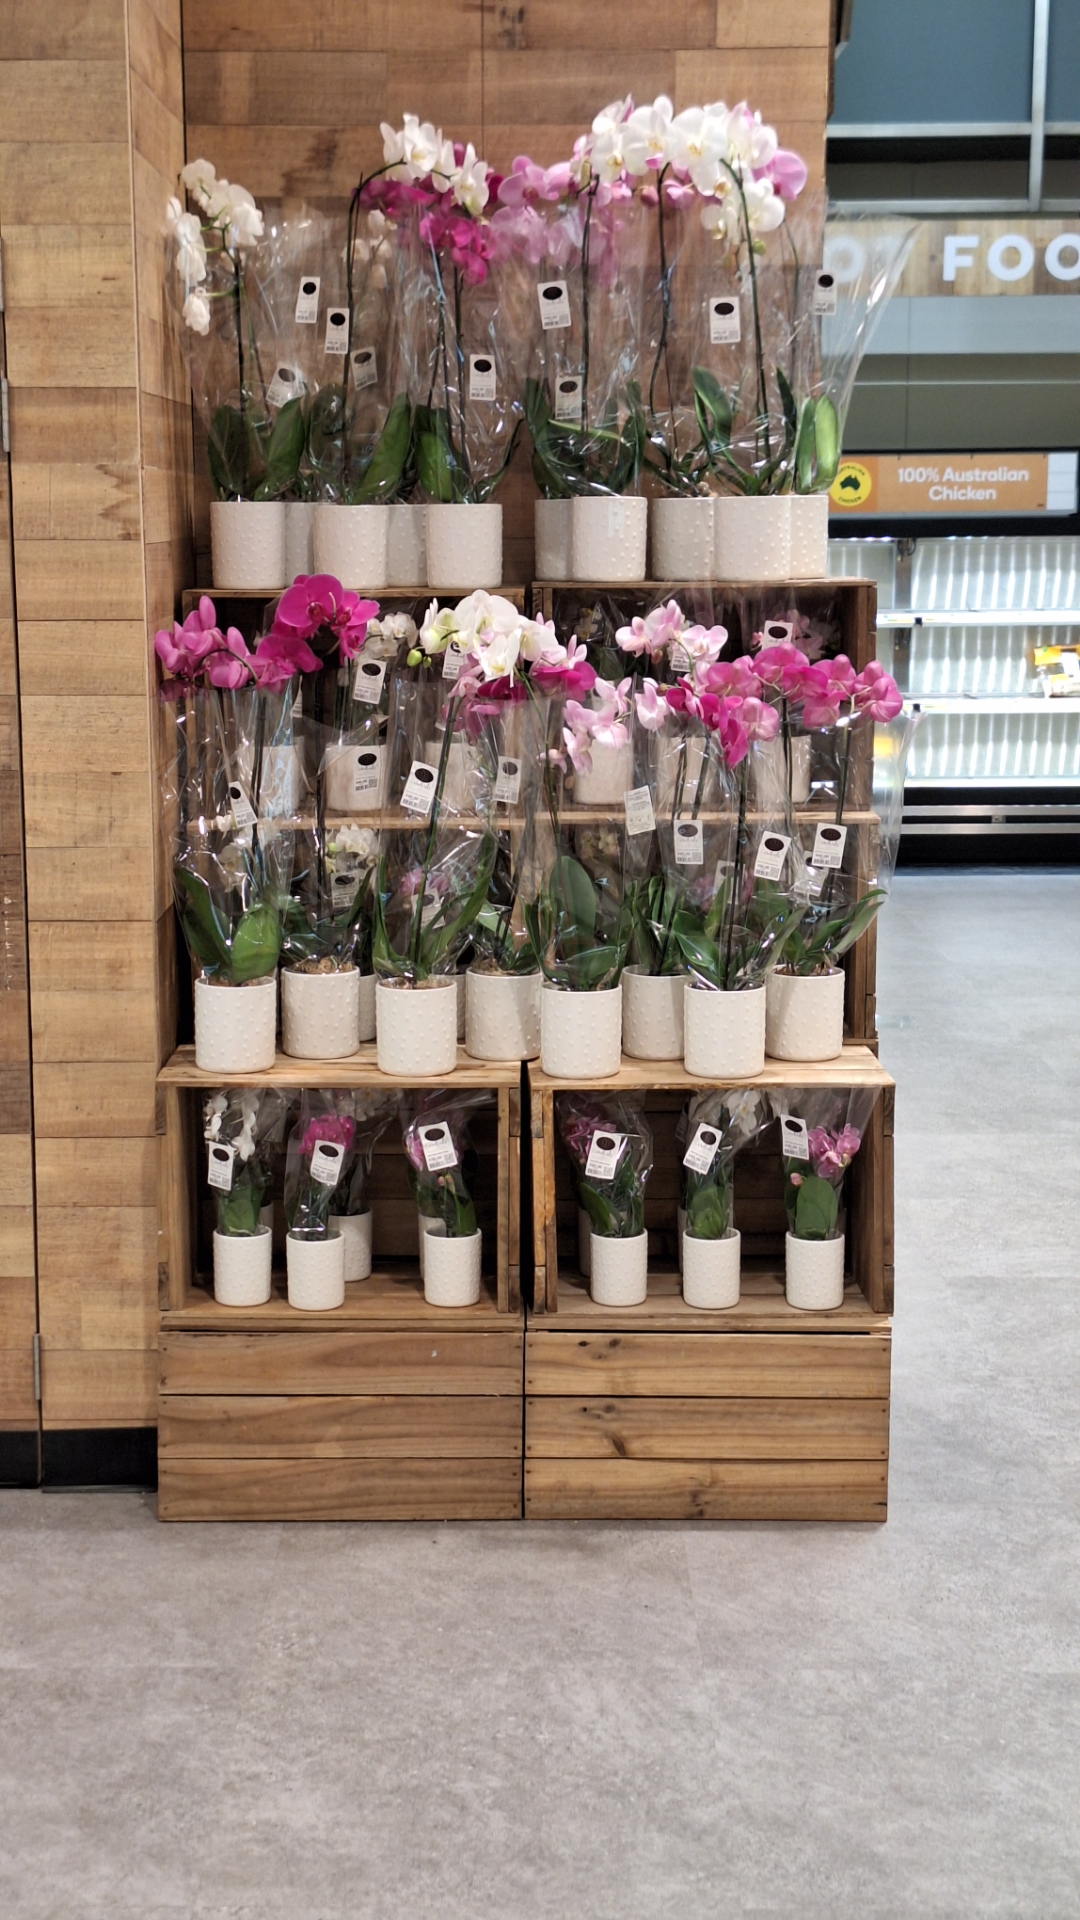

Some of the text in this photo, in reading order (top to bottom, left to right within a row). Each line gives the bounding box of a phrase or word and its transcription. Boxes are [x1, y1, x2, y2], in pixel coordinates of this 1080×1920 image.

[897, 466, 1030, 483] 100% Australian
[928, 485, 997, 501] Chicken
